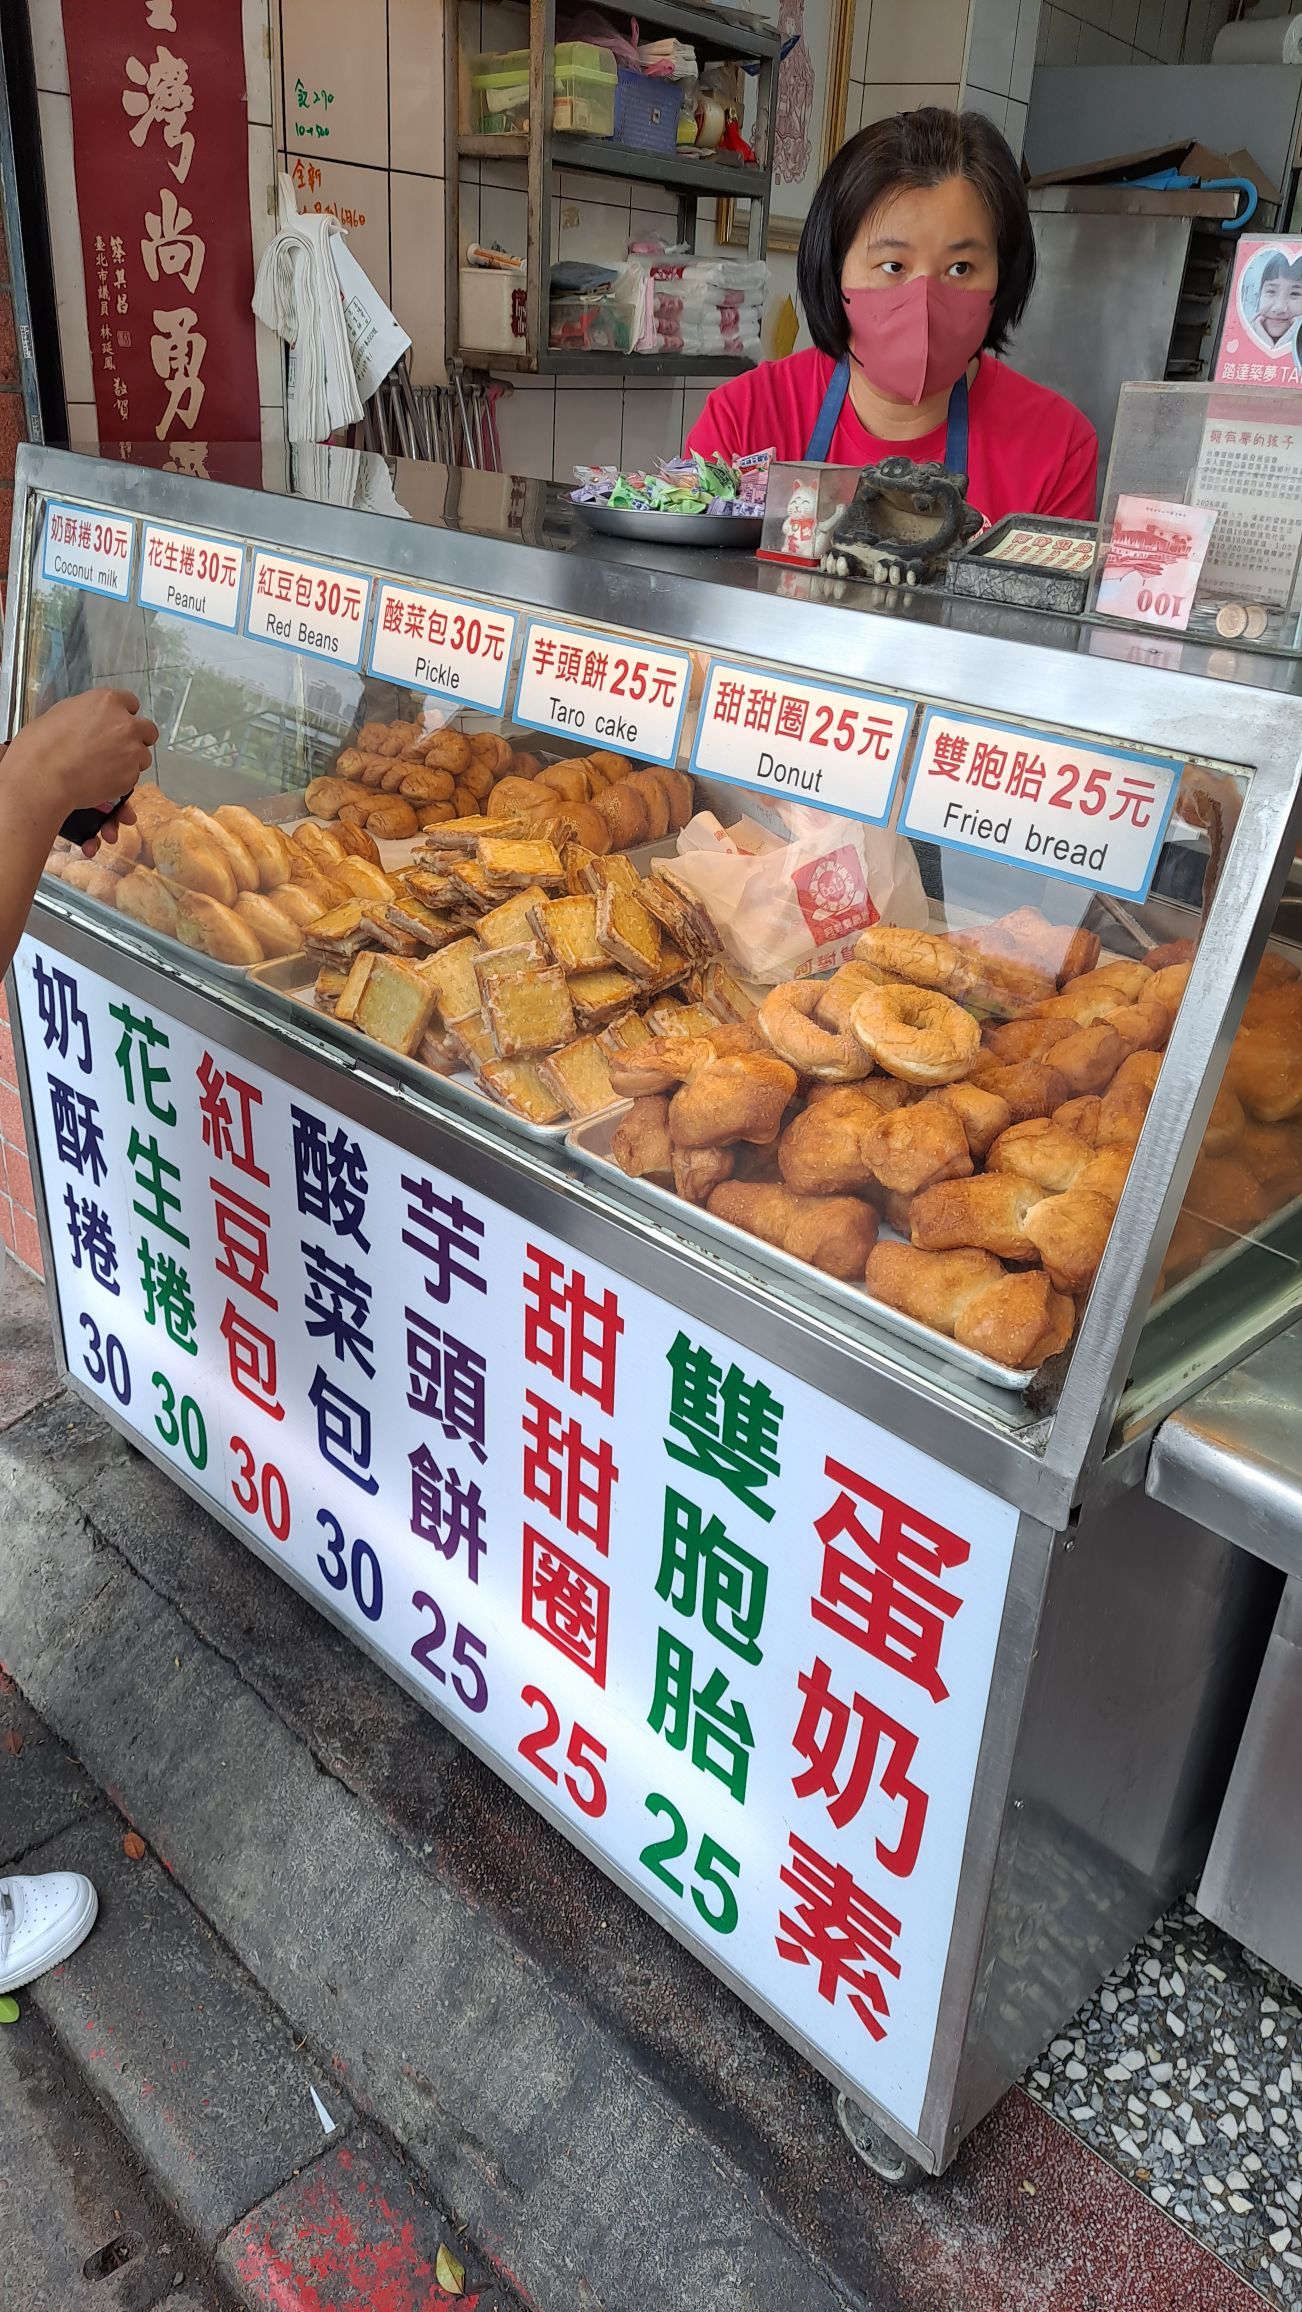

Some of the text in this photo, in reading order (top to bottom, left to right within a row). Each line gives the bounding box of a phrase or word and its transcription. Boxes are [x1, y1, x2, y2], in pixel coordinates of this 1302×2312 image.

[122, 0, 206, 441] 灣尚勇
[50, 513, 129, 559] 奶酥捲30元
[148, 536, 237, 588] 花生捲30元
[54, 555, 118, 589] Coconut milk
[167, 585, 207, 614] Peanut
[257, 564, 361, 622] 紅豆包30元
[1137, 589, 1187, 618] 100
[266, 613, 339, 653] Red Beans
[383, 597, 505, 662] 酸菜包30元
[415, 656, 460, 689] Pickle
[532, 637, 677, 708] 芋頭餅25元
[549, 696, 638, 743] Taro cake
[713, 680, 894, 762] 甜甜圈25元
[756, 751, 824, 793] Donut
[927, 731, 1156, 829] 雙胞胎25元
[943, 802, 1109, 872] Fried bread
[33, 954, 131, 1405] 奶酥捲 30
[109, 1003, 207, 1470] 花生捲 30
[196, 1052, 290, 1541] 紅豆包 30
[291, 1104, 383, 1621] 酸菜包 30
[401, 1175, 487, 1712] 芋頭餅 25
[518, 1244, 624, 1817] 甜甜圈 25
[639, 1330, 784, 1934] 雙胞胎 25
[774, 1456, 970, 2041] 蛋奶素
